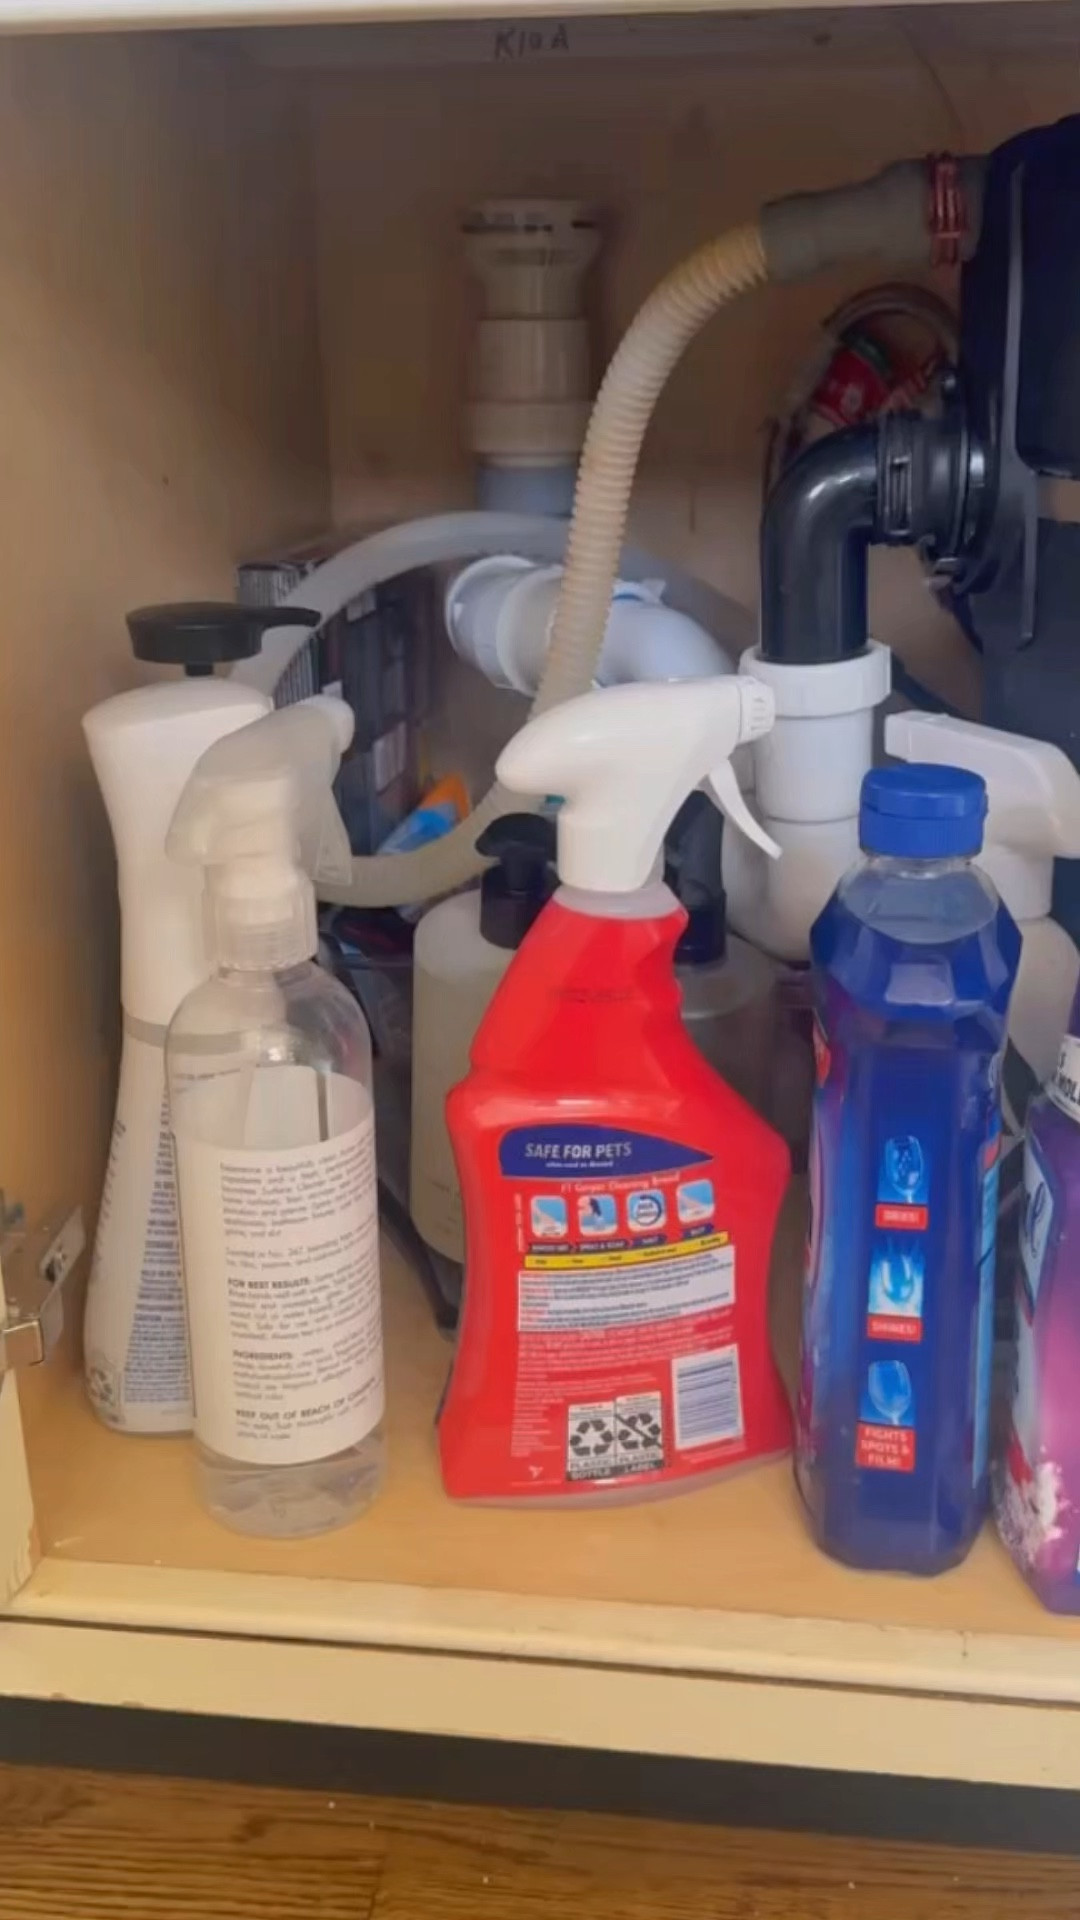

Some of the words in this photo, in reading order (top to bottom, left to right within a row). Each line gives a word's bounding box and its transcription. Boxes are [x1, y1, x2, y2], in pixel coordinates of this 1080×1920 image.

[525, 1142, 561, 1159] SAFE
[563, 1144, 592, 1159] FOR
[595, 1141, 632, 1158] PETS
[865, 1426, 908, 1442] FIGHTS
